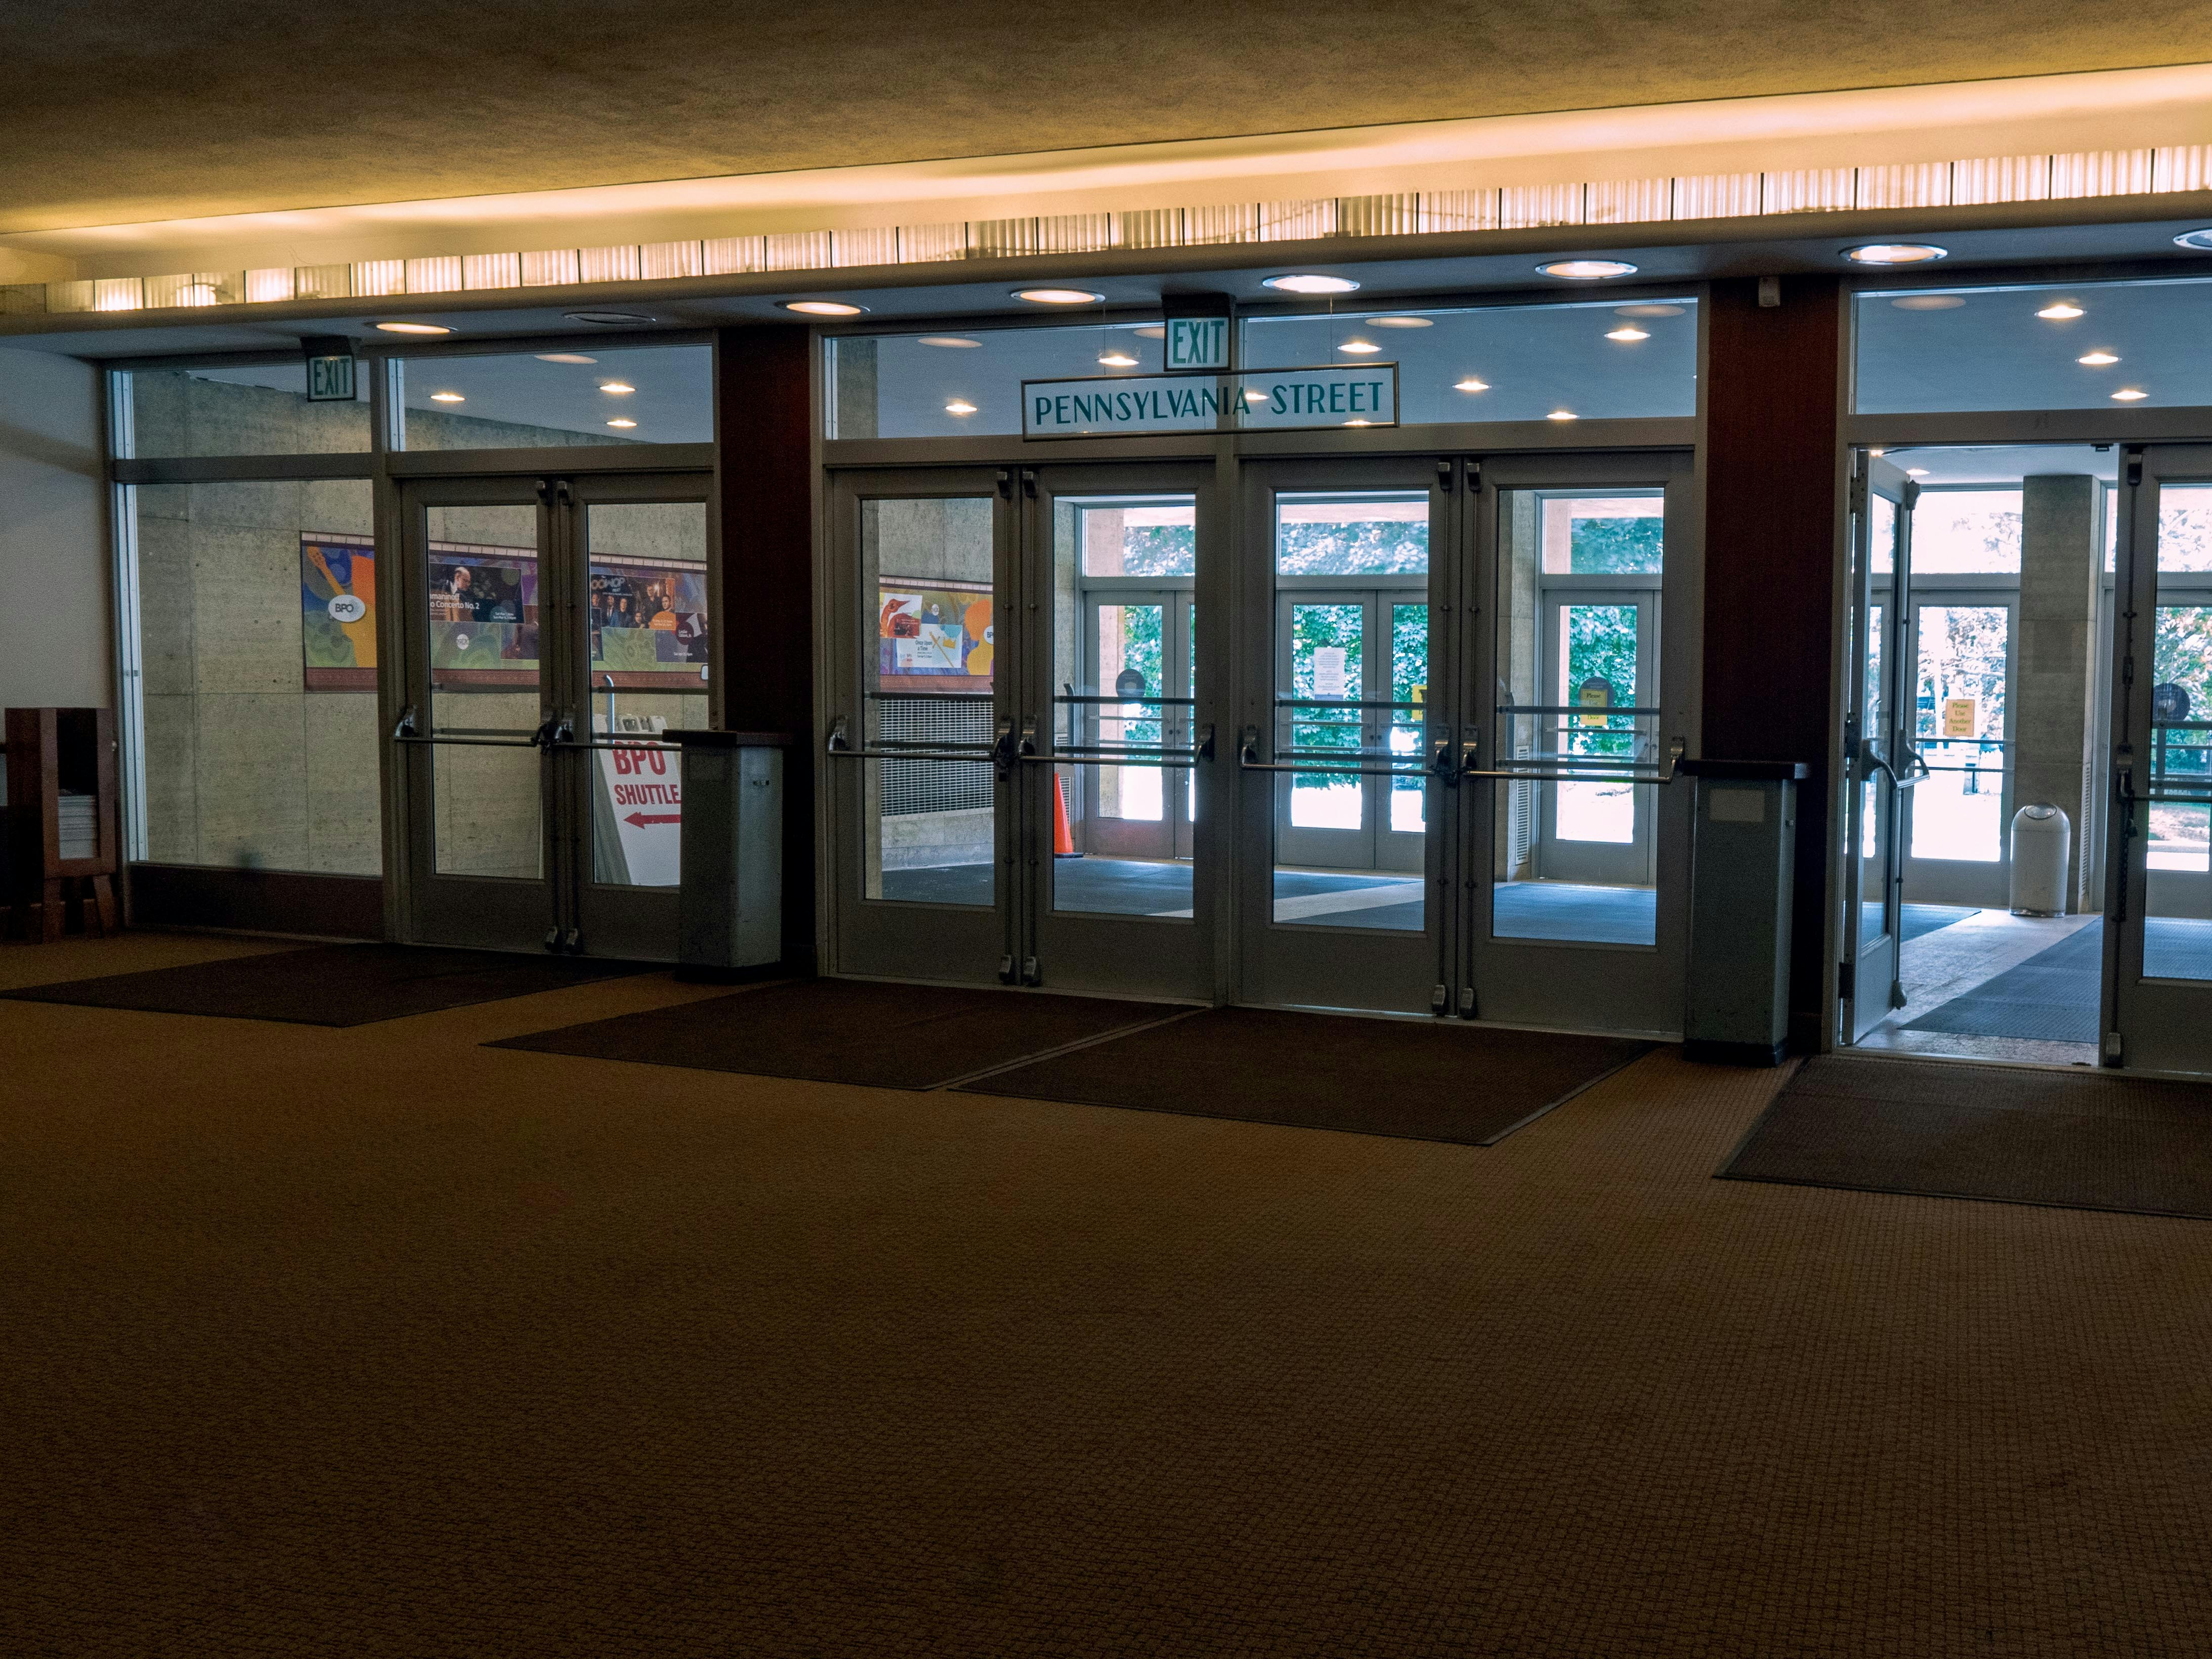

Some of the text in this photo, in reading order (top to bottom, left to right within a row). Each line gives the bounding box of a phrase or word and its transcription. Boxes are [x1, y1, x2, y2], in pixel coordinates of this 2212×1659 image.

[1173, 320, 1225, 364] EXIT
[313, 359, 350, 396] EXIT
[1035, 382, 1384, 426] PENNSYLVANIA STREET
[335, 603, 354, 613] BPO
[436, 601, 464, 609] Concerto
[612, 741, 666, 775] BPO
[614, 784, 681, 805] SHUTTLE
